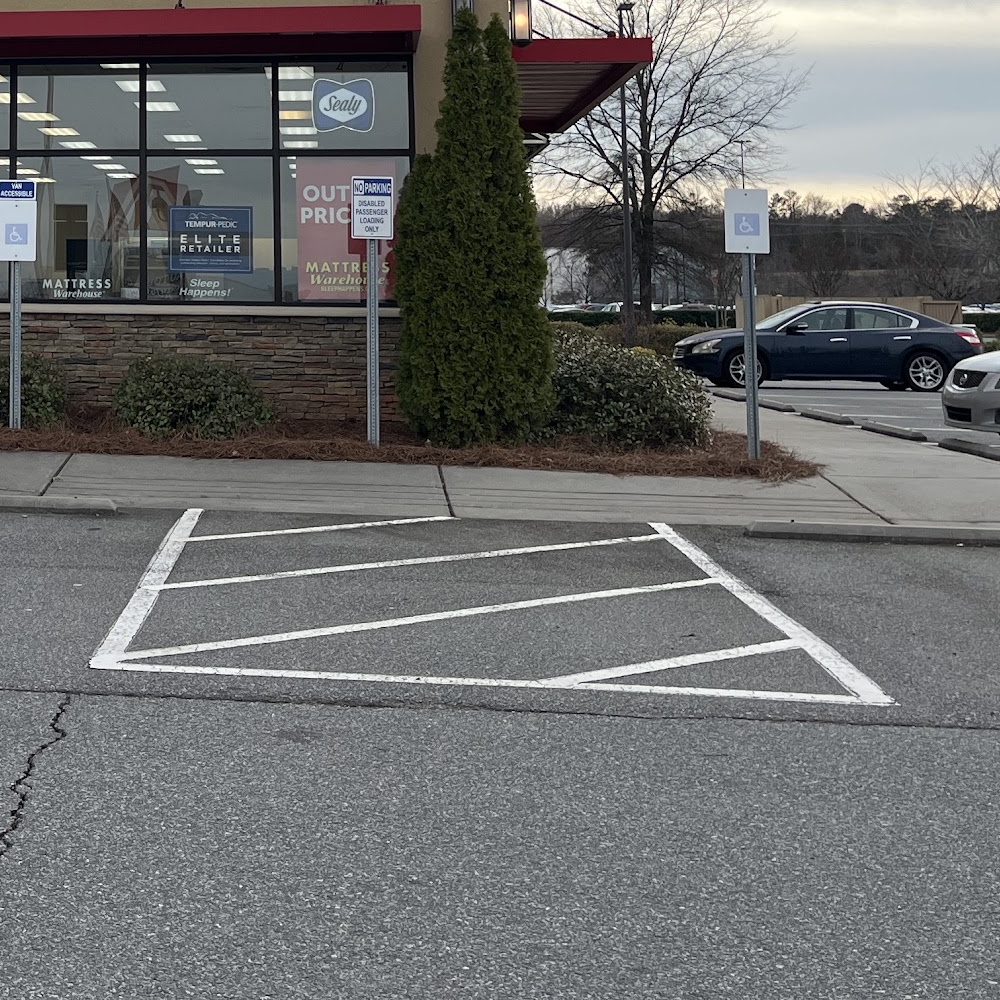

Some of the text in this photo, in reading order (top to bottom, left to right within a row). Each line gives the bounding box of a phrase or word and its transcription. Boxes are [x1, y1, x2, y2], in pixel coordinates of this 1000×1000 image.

[323, 95, 362, 115] Sealy
[354, 182, 391, 193] NO PARKING
[302, 185, 350, 202] OUT
[301, 207, 351, 224] PRIC
[185, 220, 238, 228] TEMPUR-PEDIC
[180, 234, 241, 244] ELITE
[180, 245, 241, 253] RETAILER
[306, 262, 390, 273] MATTRES
[42, 279, 112, 289] MATTRESS
[189, 279, 220, 289] Sleep
[310, 274, 386, 285] Warehoe
[53, 289, 103, 298] Warehouse
[179, 287, 231, 298] Happens!
